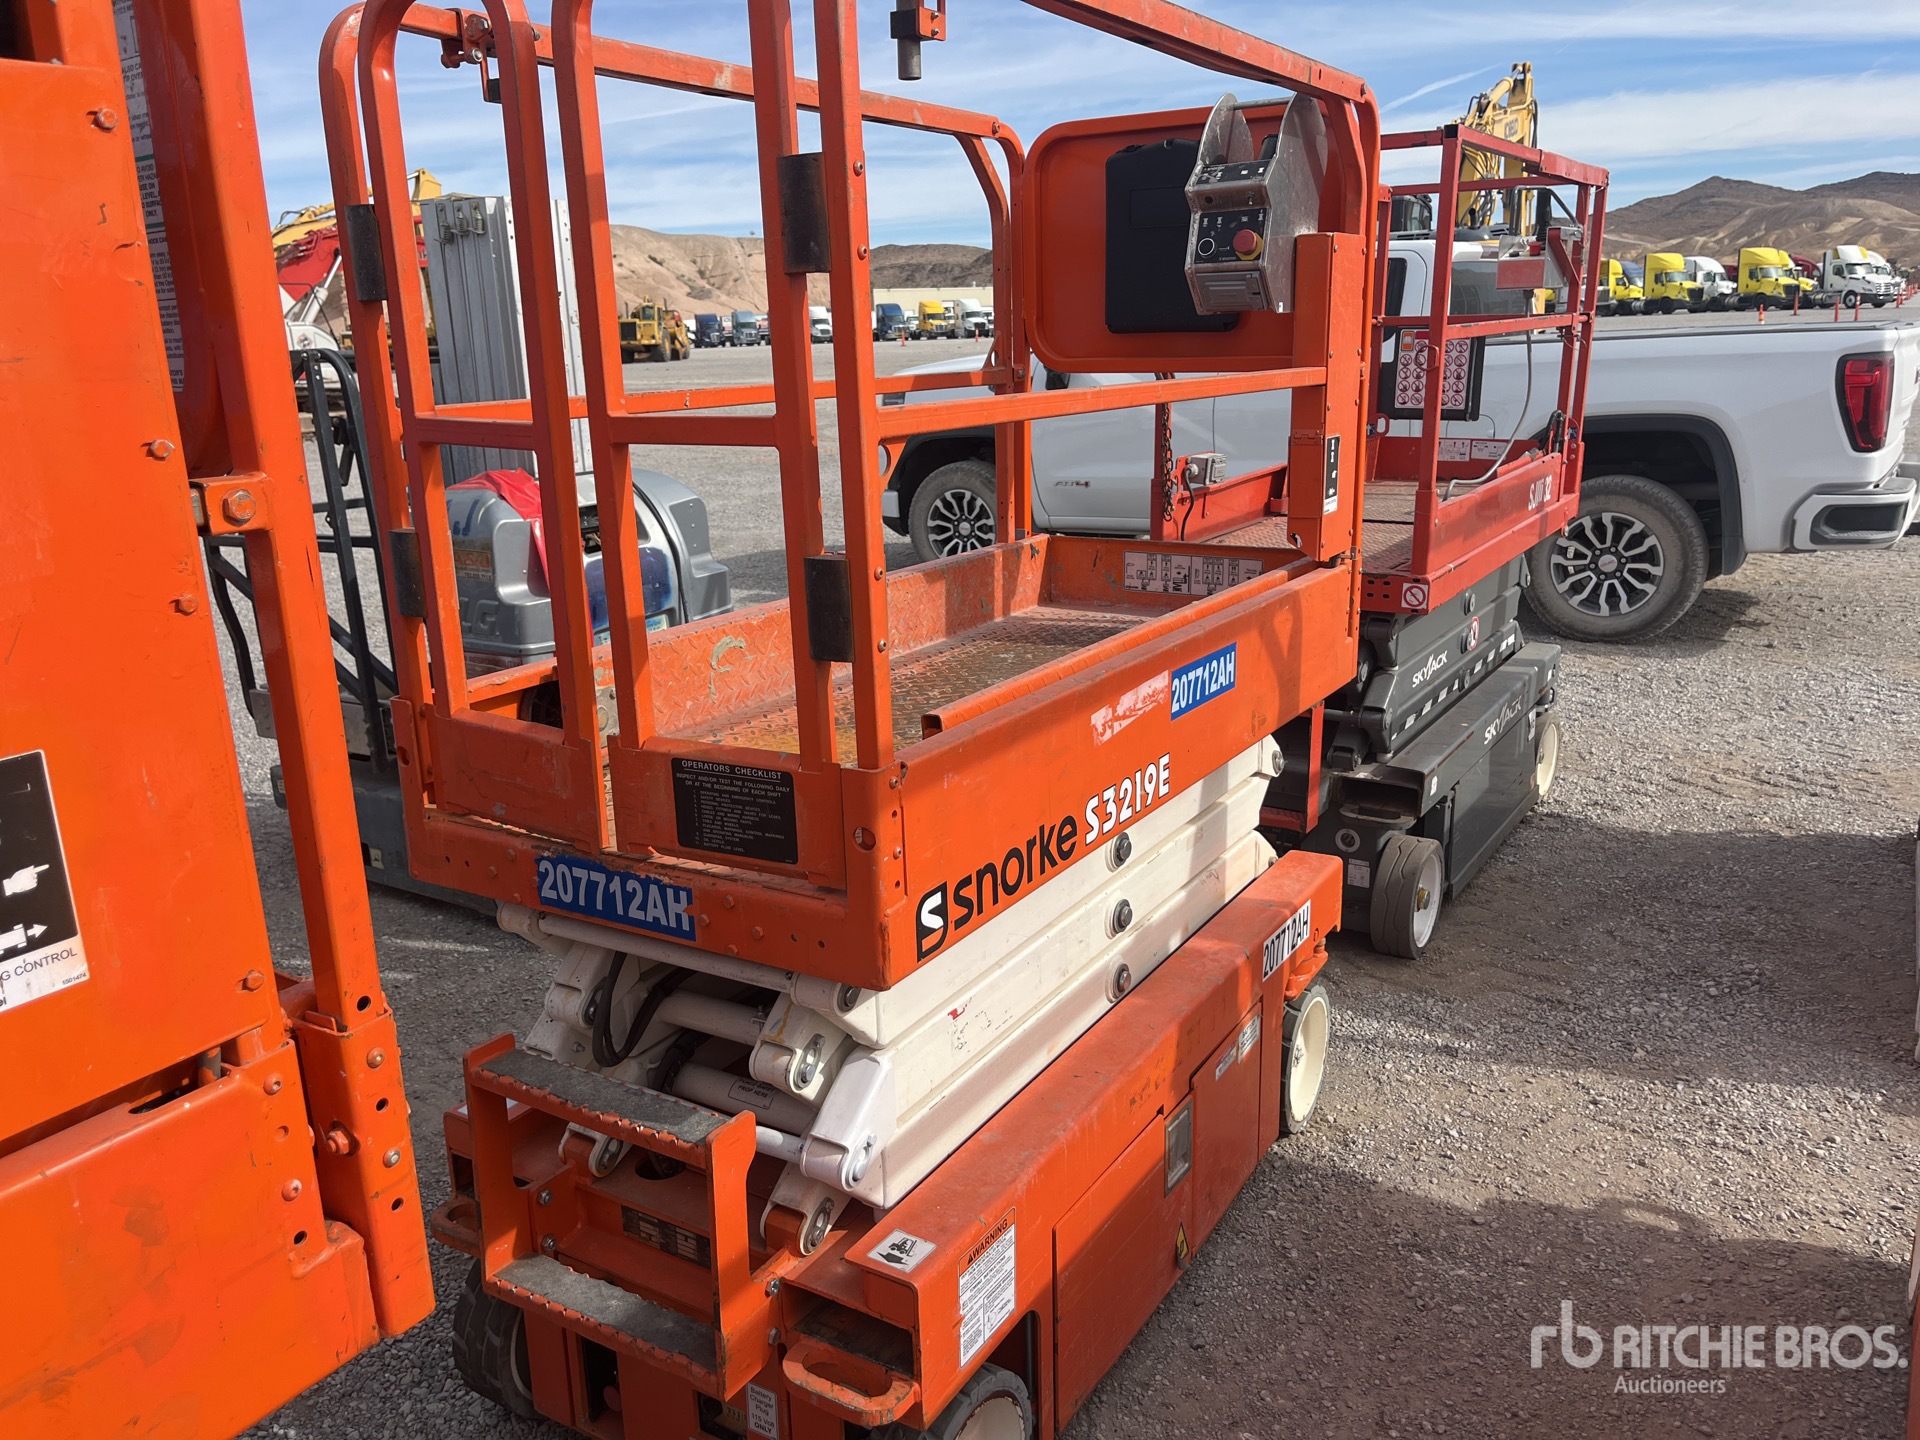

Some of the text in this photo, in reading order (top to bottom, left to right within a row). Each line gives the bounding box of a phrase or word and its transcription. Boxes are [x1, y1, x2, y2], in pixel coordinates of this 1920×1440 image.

[1412, 650, 1448, 688] SKYJACK
[1171, 651, 1235, 714] 207712AH
[682, 760, 782, 779] OPERATORS CHECKLIST
[714, 784, 740, 792] BEGINNING
[744, 782, 773, 790] FOLLOWING
[1085, 752, 1170, 846] S3219E
[539, 859, 690, 932] 207712AH
[1263, 905, 1309, 979] 207712AH
[14, 948, 78, 976] CONTROL
[754, 1090, 769, 1098] HERE
[973, 1219, 1008, 1259] WARNING
[750, 1386, 771, 1402] Battery
[750, 1394, 774, 1408] Charger
[756, 1404, 769, 1416] Plug
[752, 1412, 762, 1422] 115
[763, 1418, 774, 1428] Volt
[754, 1422, 772, 1434] ONLY
